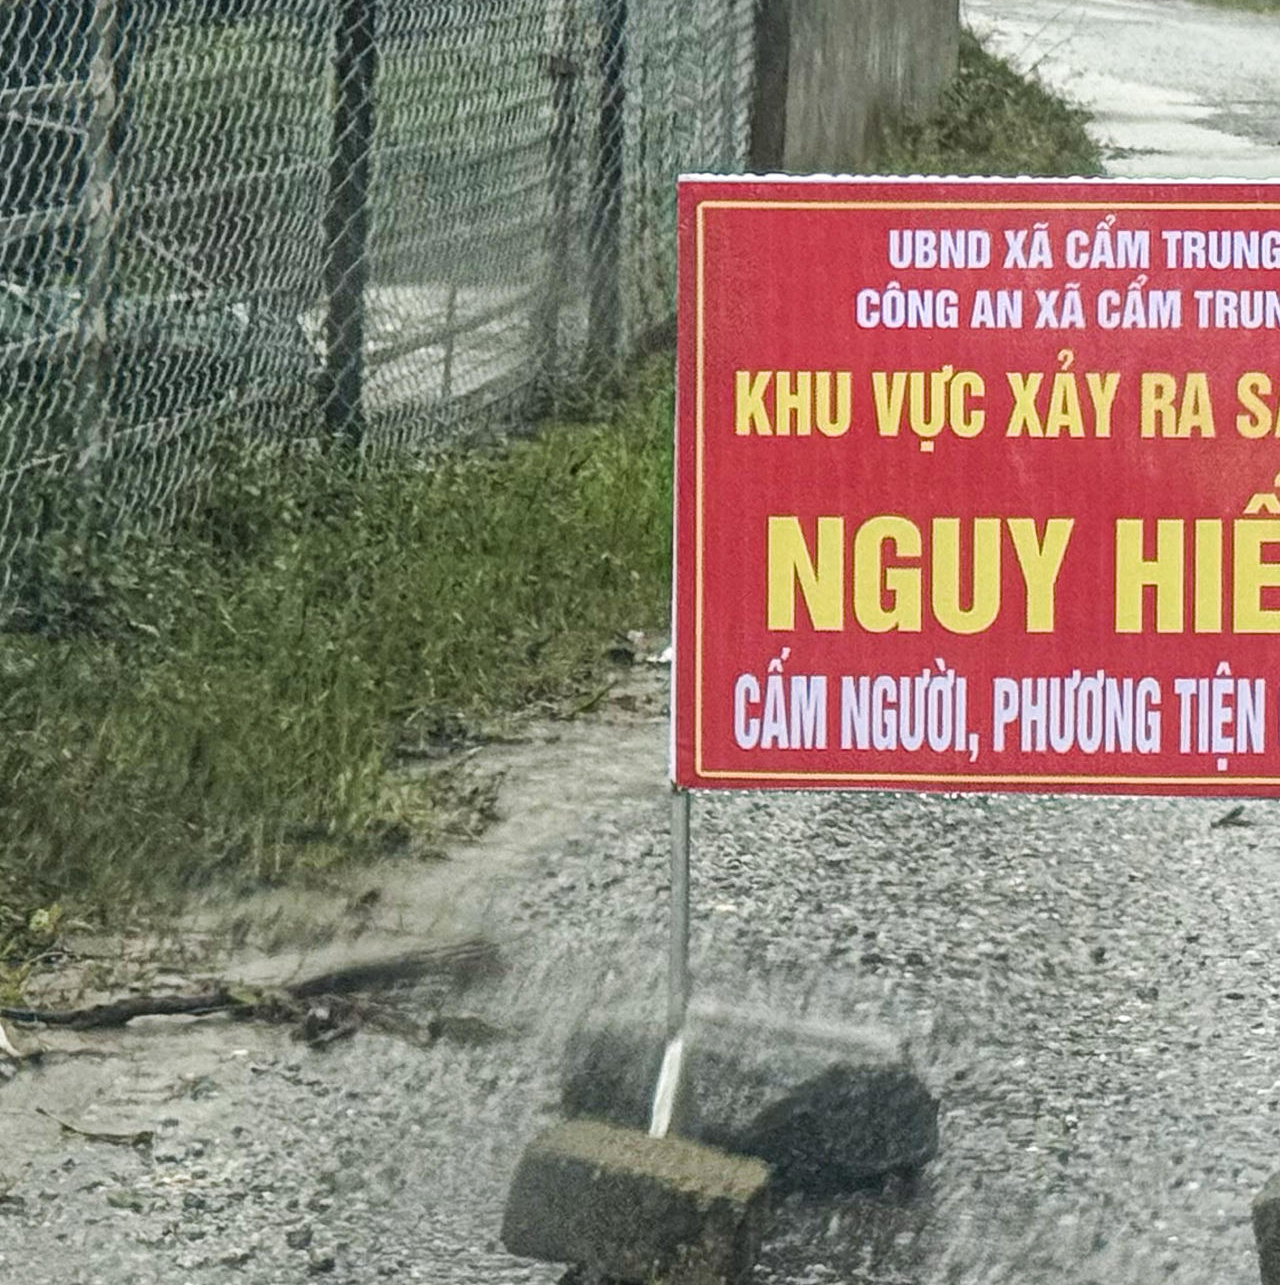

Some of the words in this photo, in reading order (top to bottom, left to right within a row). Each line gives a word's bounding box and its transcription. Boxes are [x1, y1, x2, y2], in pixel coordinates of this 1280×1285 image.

[888, 228, 992, 270] UBND
[1002, 221, 1054, 270] XÃ
[1065, 213, 1150, 270] CẨM
[856, 280, 959, 329] CÔNG
[970, 287, 1023, 329] AN
[1034, 281, 1087, 330] XÃ
[1097, 273, 1183, 330] CẨM
[735, 370, 853, 437] KHU
[871, 364, 986, 453] VỰC
[1005, 348, 1122, 438] XẢY
[1140, 371, 1216, 439] RA
[767, 515, 1075, 635] NGUY
[734, 647, 828, 750] CẤM
[840, 657, 980, 763] NGƯỜI,
[993, 669, 1162, 754] PHƯƠNG
[1174, 661, 1267, 772] TIỆN
